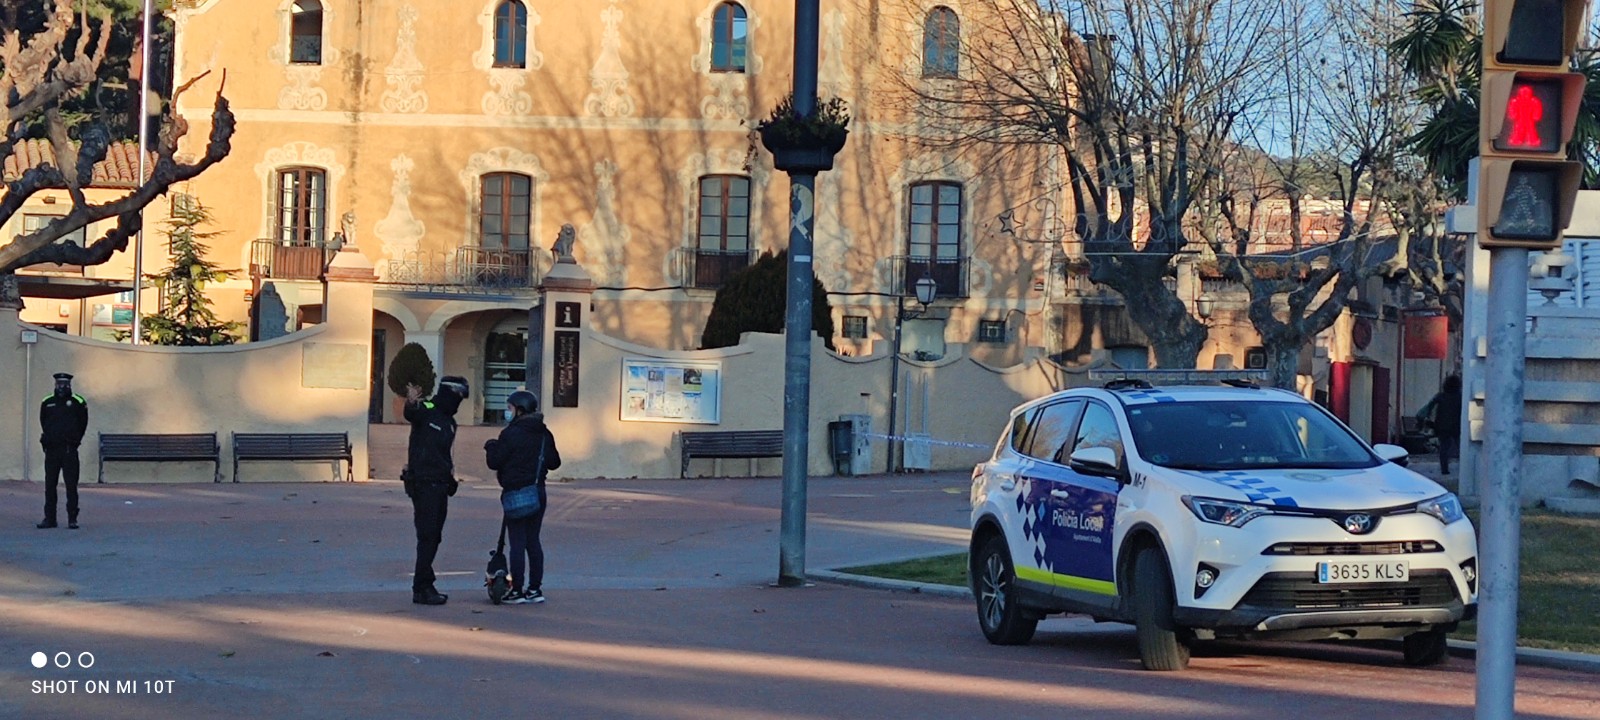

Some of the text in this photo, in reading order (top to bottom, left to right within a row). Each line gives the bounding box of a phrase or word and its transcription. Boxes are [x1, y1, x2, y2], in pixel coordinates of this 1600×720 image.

[563, 306, 572, 323] i
[1134, 472, 1147, 489] M-1
[1080, 513, 1104, 532] Local
[1331, 563, 1404, 580] 3635 KLS
